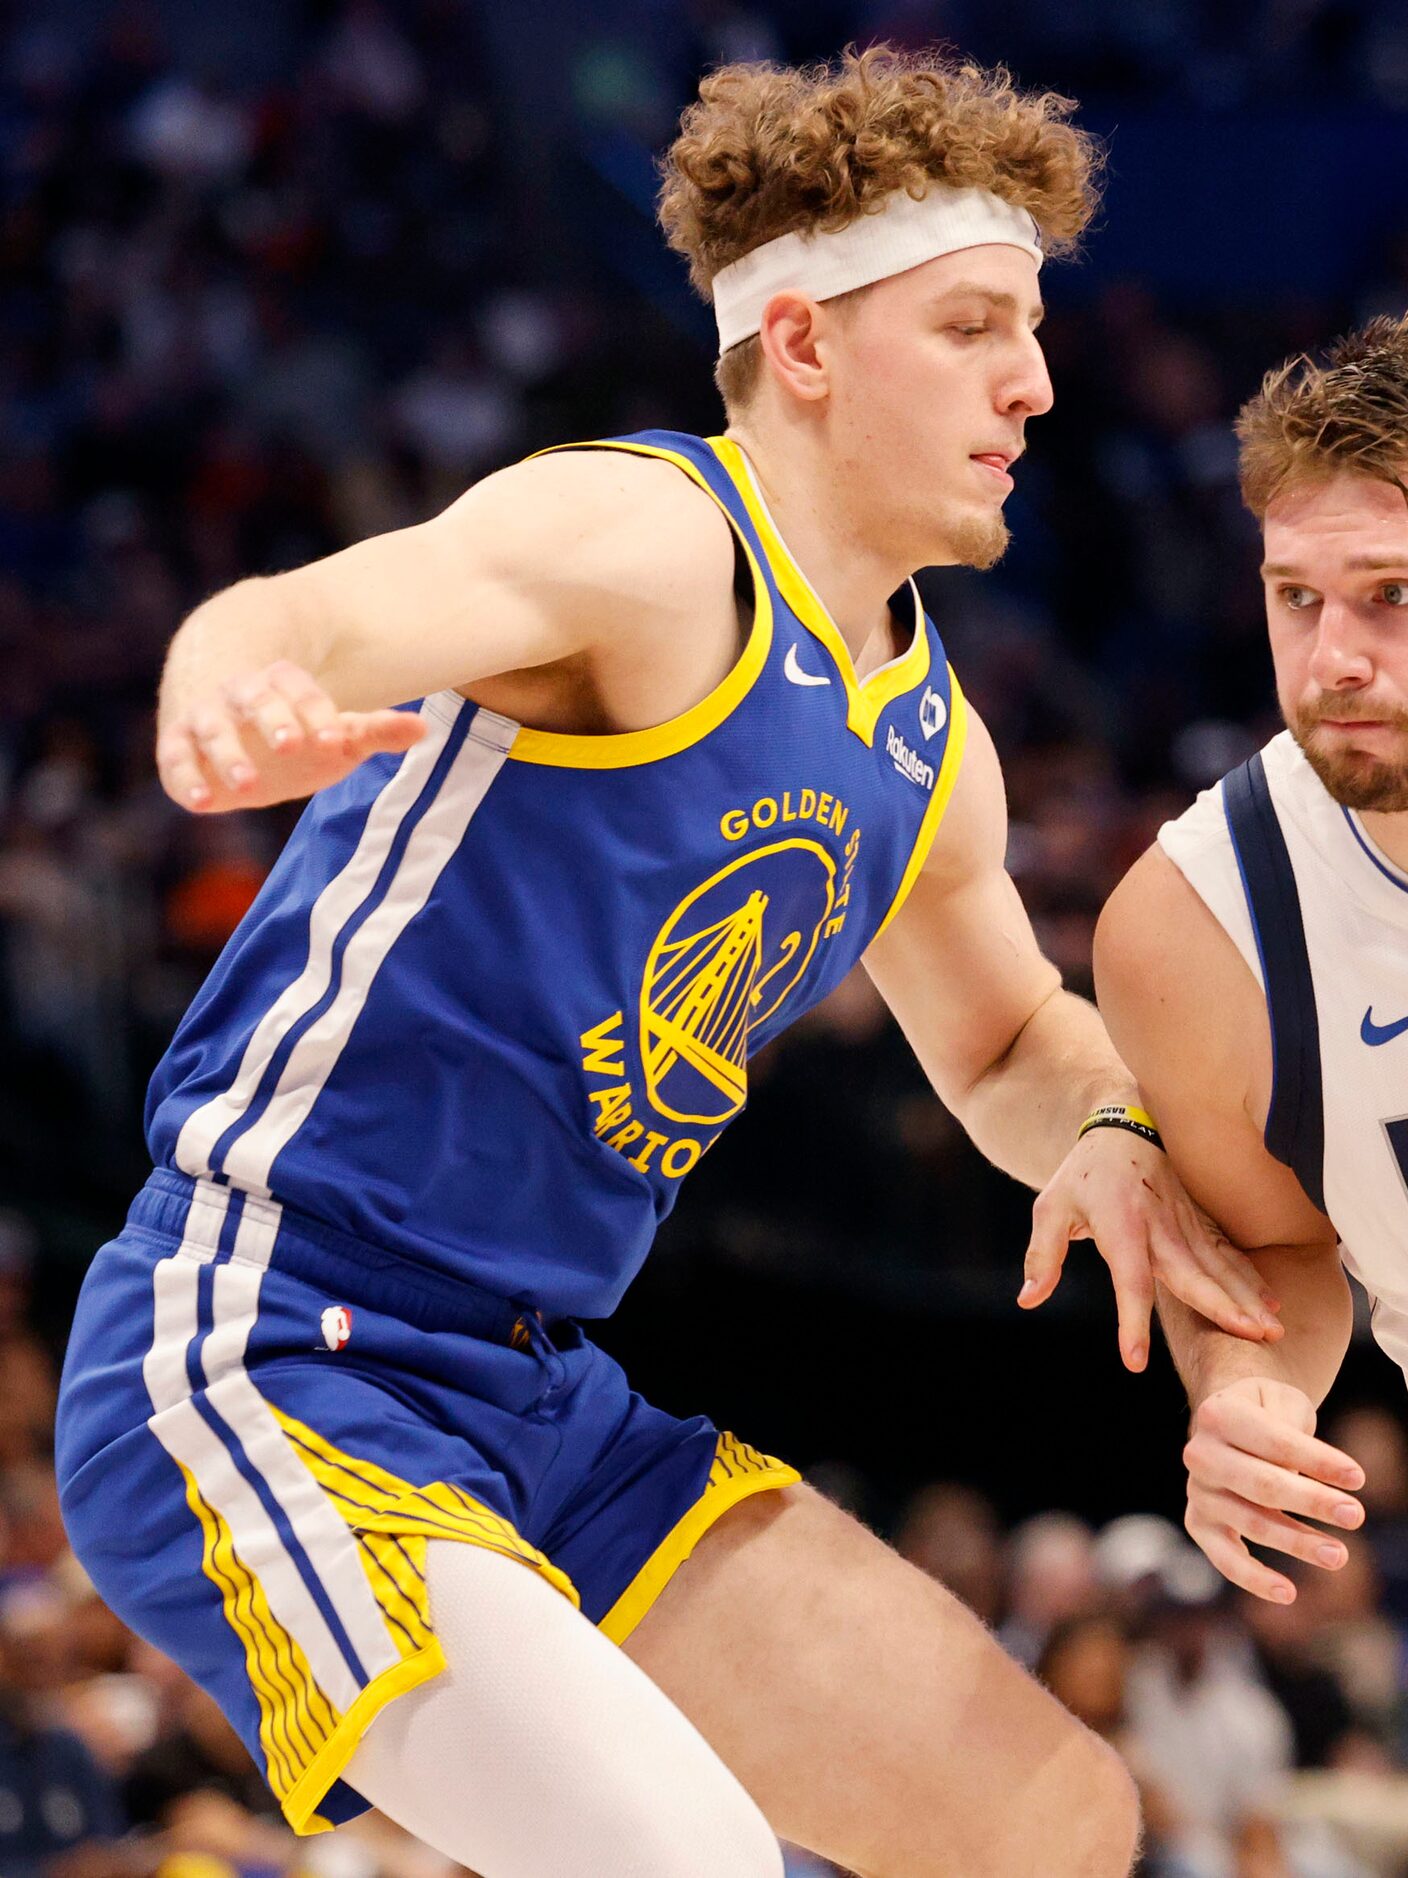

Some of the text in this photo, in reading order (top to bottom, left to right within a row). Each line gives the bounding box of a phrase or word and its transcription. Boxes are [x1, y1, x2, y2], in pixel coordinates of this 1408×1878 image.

[886, 724, 935, 790] Rakuten
[720, 788, 849, 836] GOLDEN
[580, 1010, 721, 1178] WARRIO
